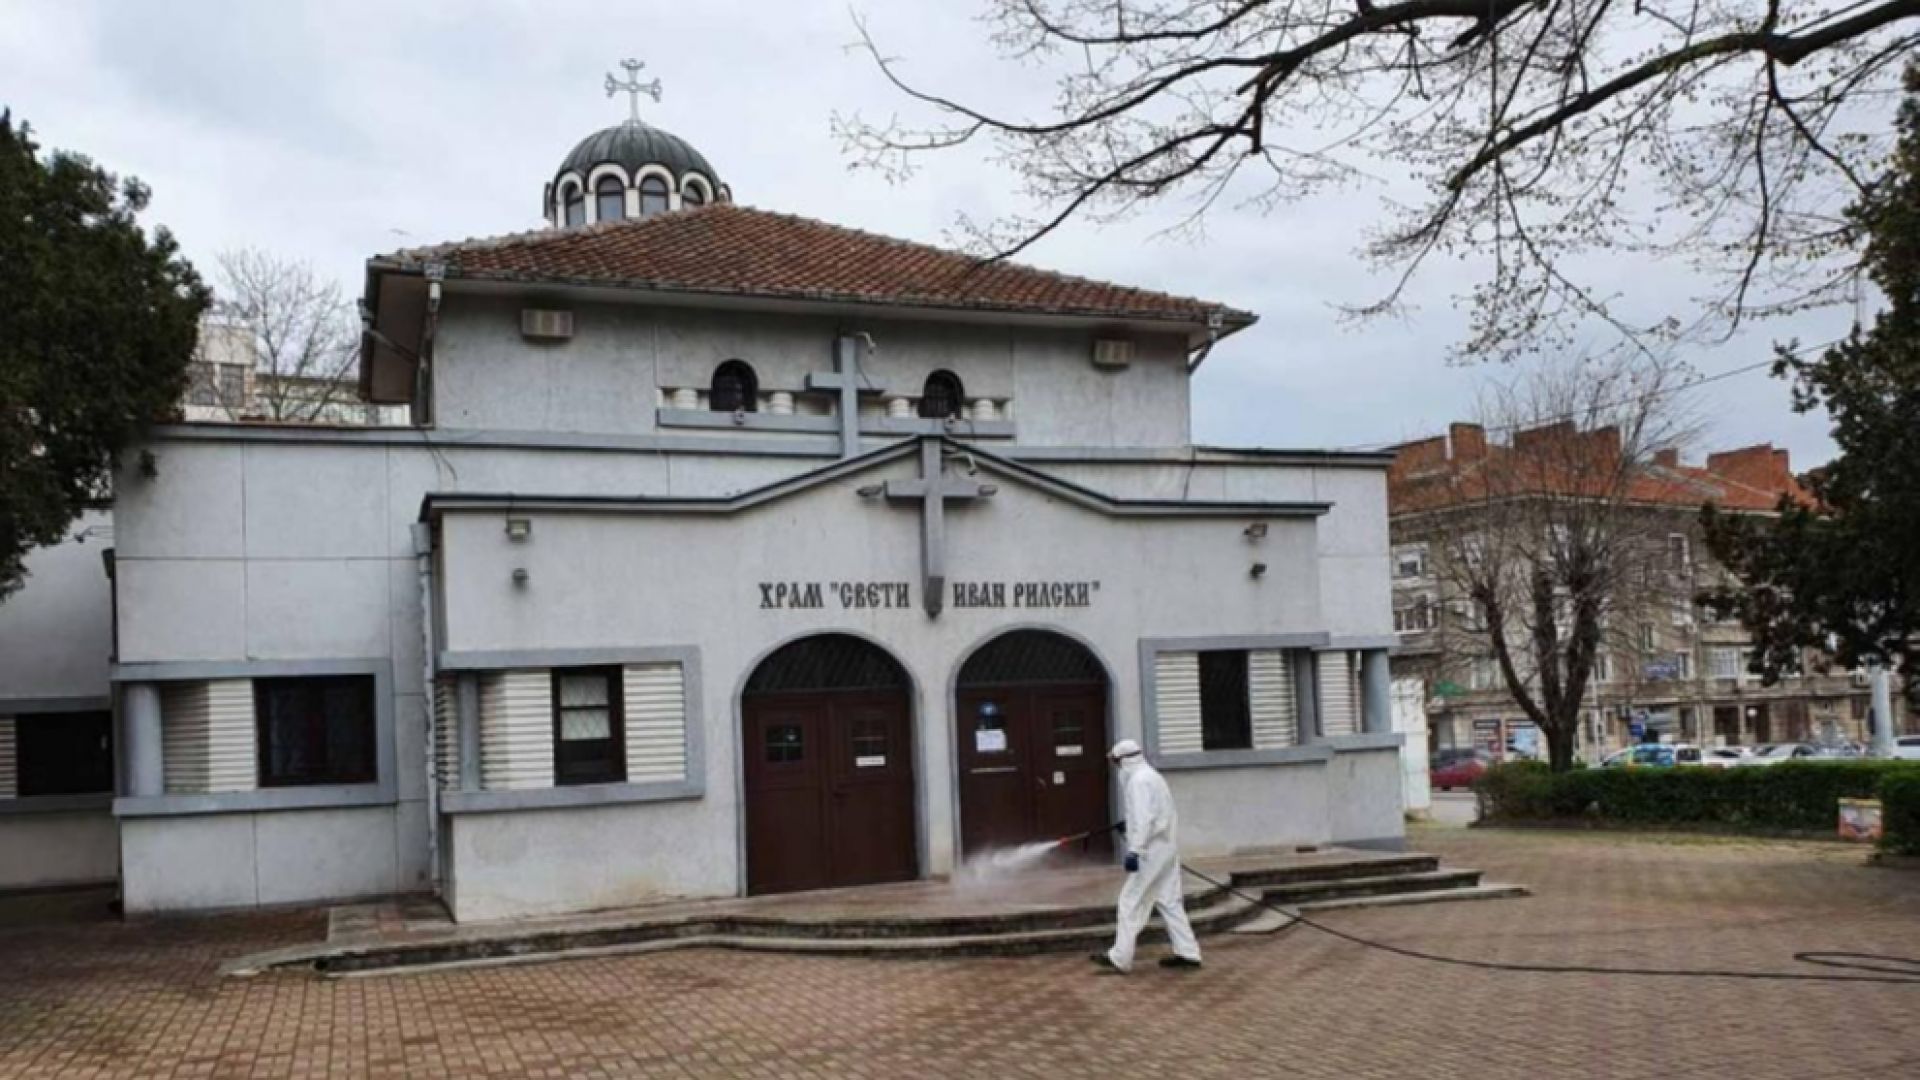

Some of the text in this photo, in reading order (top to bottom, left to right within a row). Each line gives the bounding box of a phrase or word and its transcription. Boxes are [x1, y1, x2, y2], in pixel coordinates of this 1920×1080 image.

[759, 580, 1101, 609] ХРАМ "СВЕТИ ИВАН РИЛСКИ"
